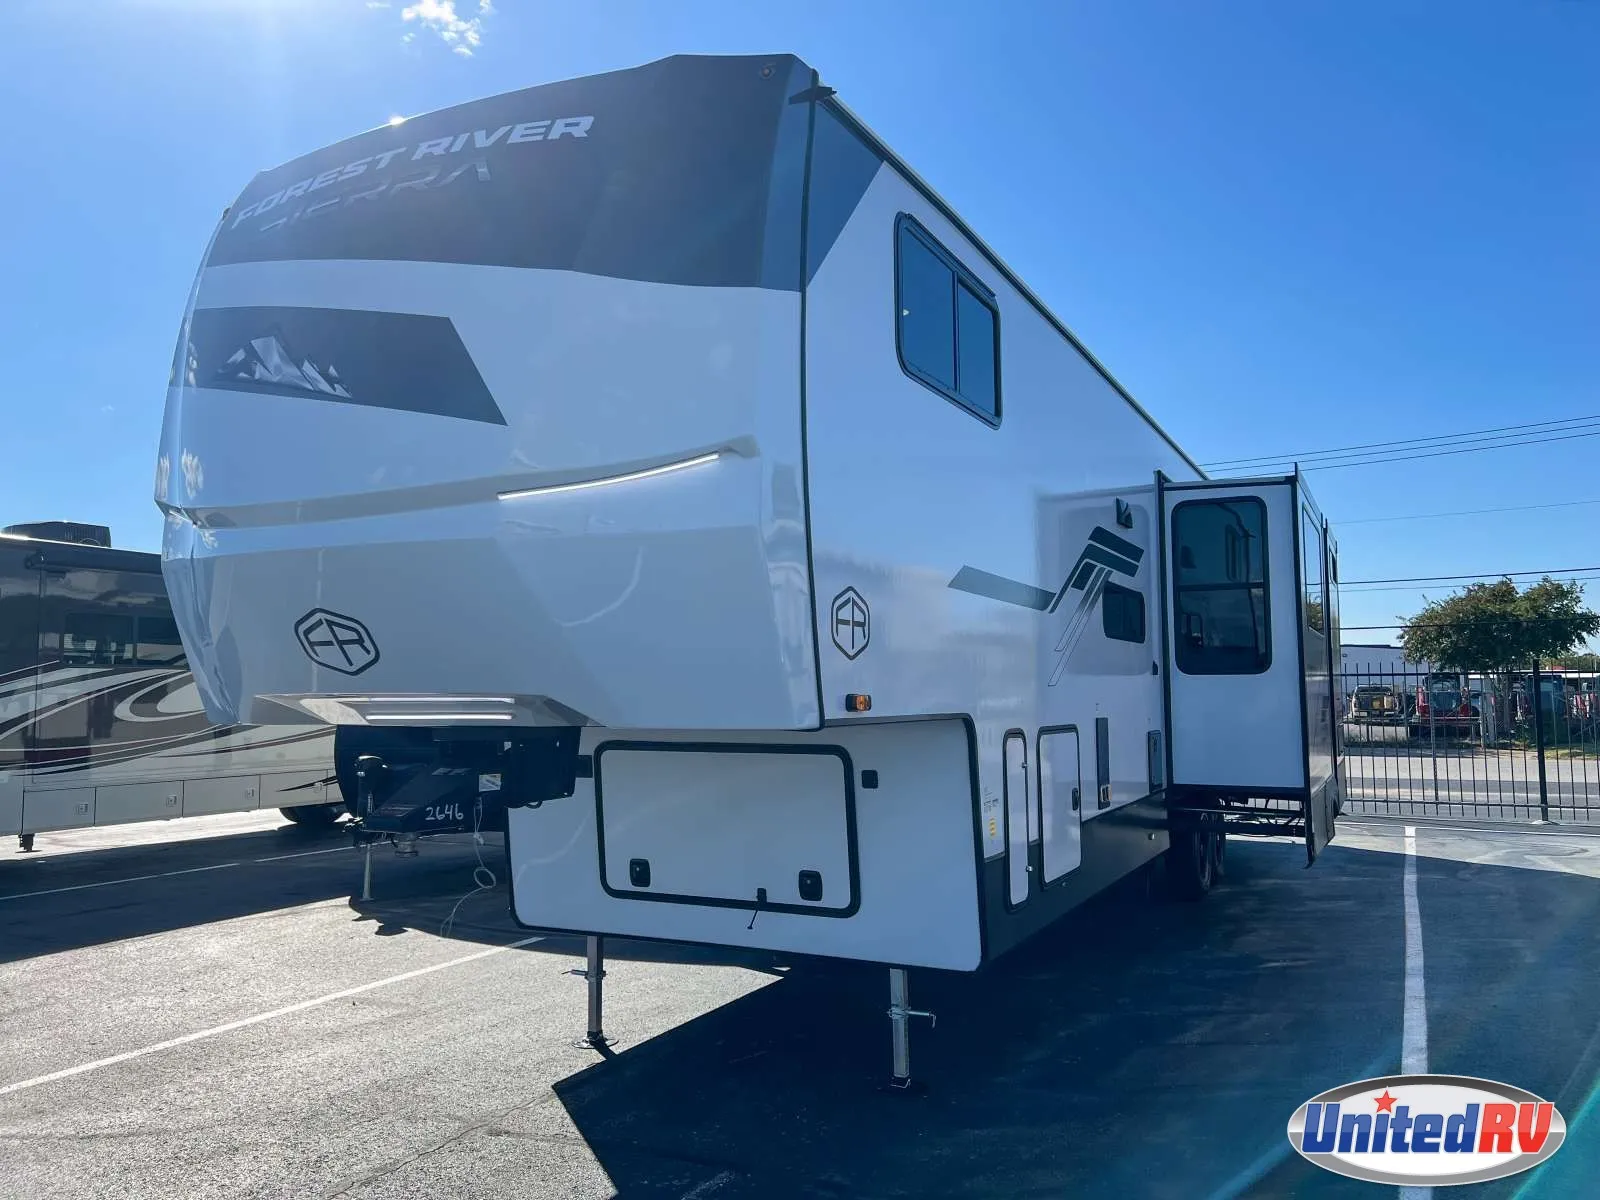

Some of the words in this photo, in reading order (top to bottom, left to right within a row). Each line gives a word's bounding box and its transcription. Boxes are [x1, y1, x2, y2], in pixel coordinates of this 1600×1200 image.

[231, 147, 408, 230] FOREST
[410, 115, 595, 161] RIVER
[425, 803, 464, 821] 2646
